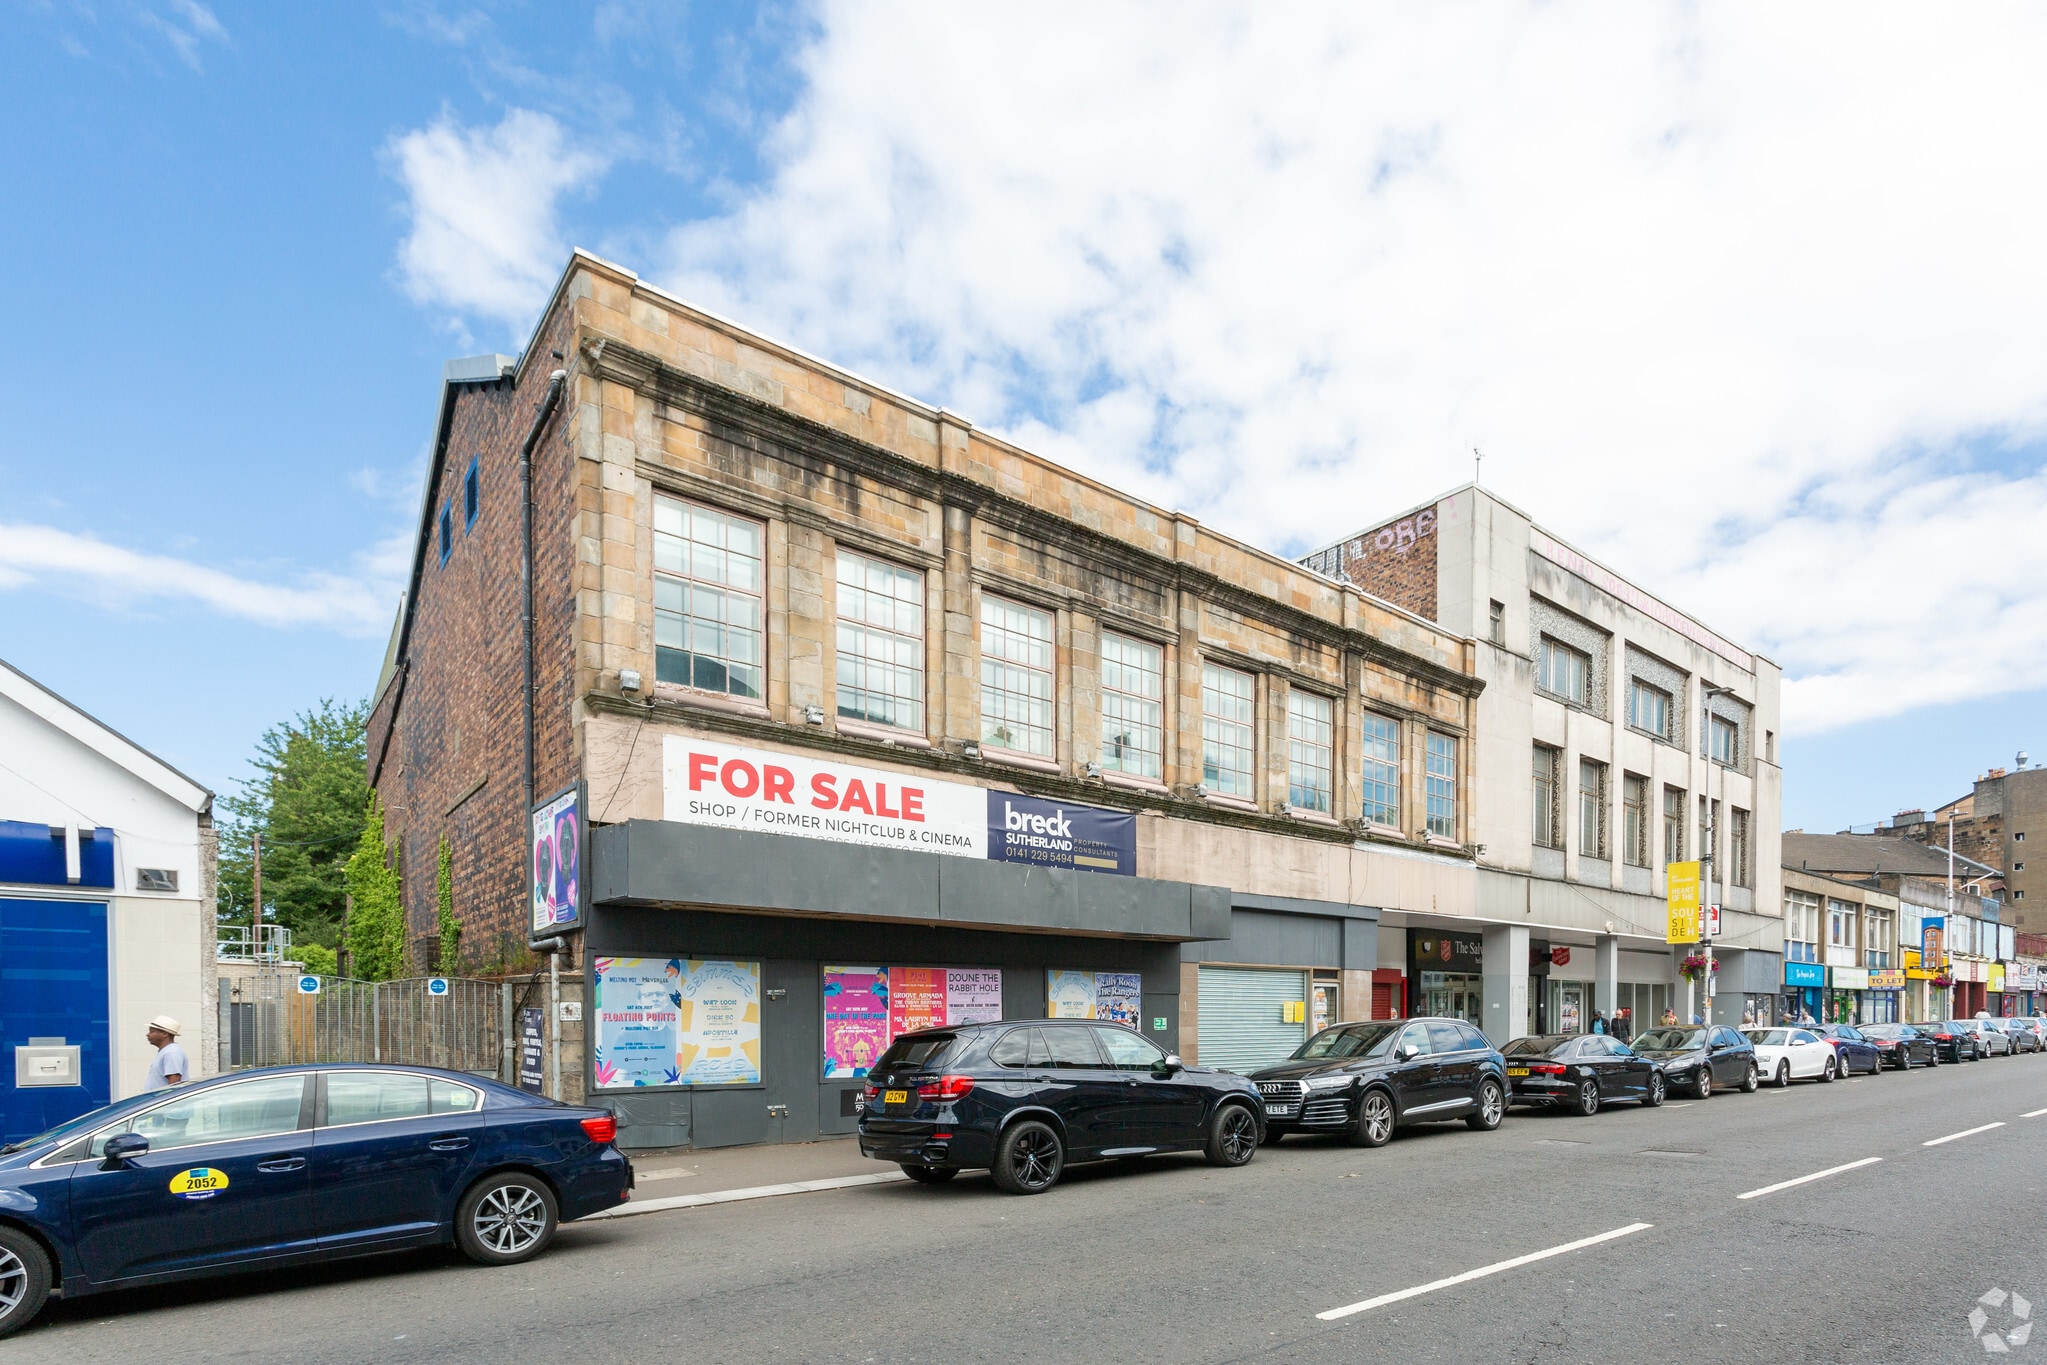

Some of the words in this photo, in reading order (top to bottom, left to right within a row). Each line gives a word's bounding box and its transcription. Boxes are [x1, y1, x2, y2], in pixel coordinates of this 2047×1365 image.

[689, 752, 795, 804] FOR
[811, 772, 925, 822] SALE
[689, 800, 736, 818] SHOP
[754, 809, 820, 829] FORMER
[826, 818, 906, 840] NIGHTCLUB
[909, 829, 918, 841] &
[922, 831, 972, 848] CINEMA
[1005, 801, 1072, 838] breck
[1005, 832, 1072, 851] SUTHERLAND
[1074, 838, 1108, 848] PROPERTY
[1006, 846, 1027, 858] 0141
[1031, 849, 1048, 861] 229
[1050, 852, 1072, 864] 5494
[1074, 847, 1118, 858] CONSULTANTS
[1671, 887, 1694, 895] HEART
[1682, 893, 1694, 901] THE
[1455, 941, 1468, 954] The
[949, 974, 979, 982] DOUNE
[982, 974, 998, 982] THE
[949, 984, 977, 992] RABBIT
[980, 984, 998, 992] HOLE
[1112, 987, 1140, 999] Rangers
[602, 1013, 644, 1021] FLOATING
[646, 1013, 676, 1021] POINTS
[886, 1091, 893, 1101] J2
[894, 1091, 905, 1101] GYM
[187, 1177, 217, 1189] 2052
